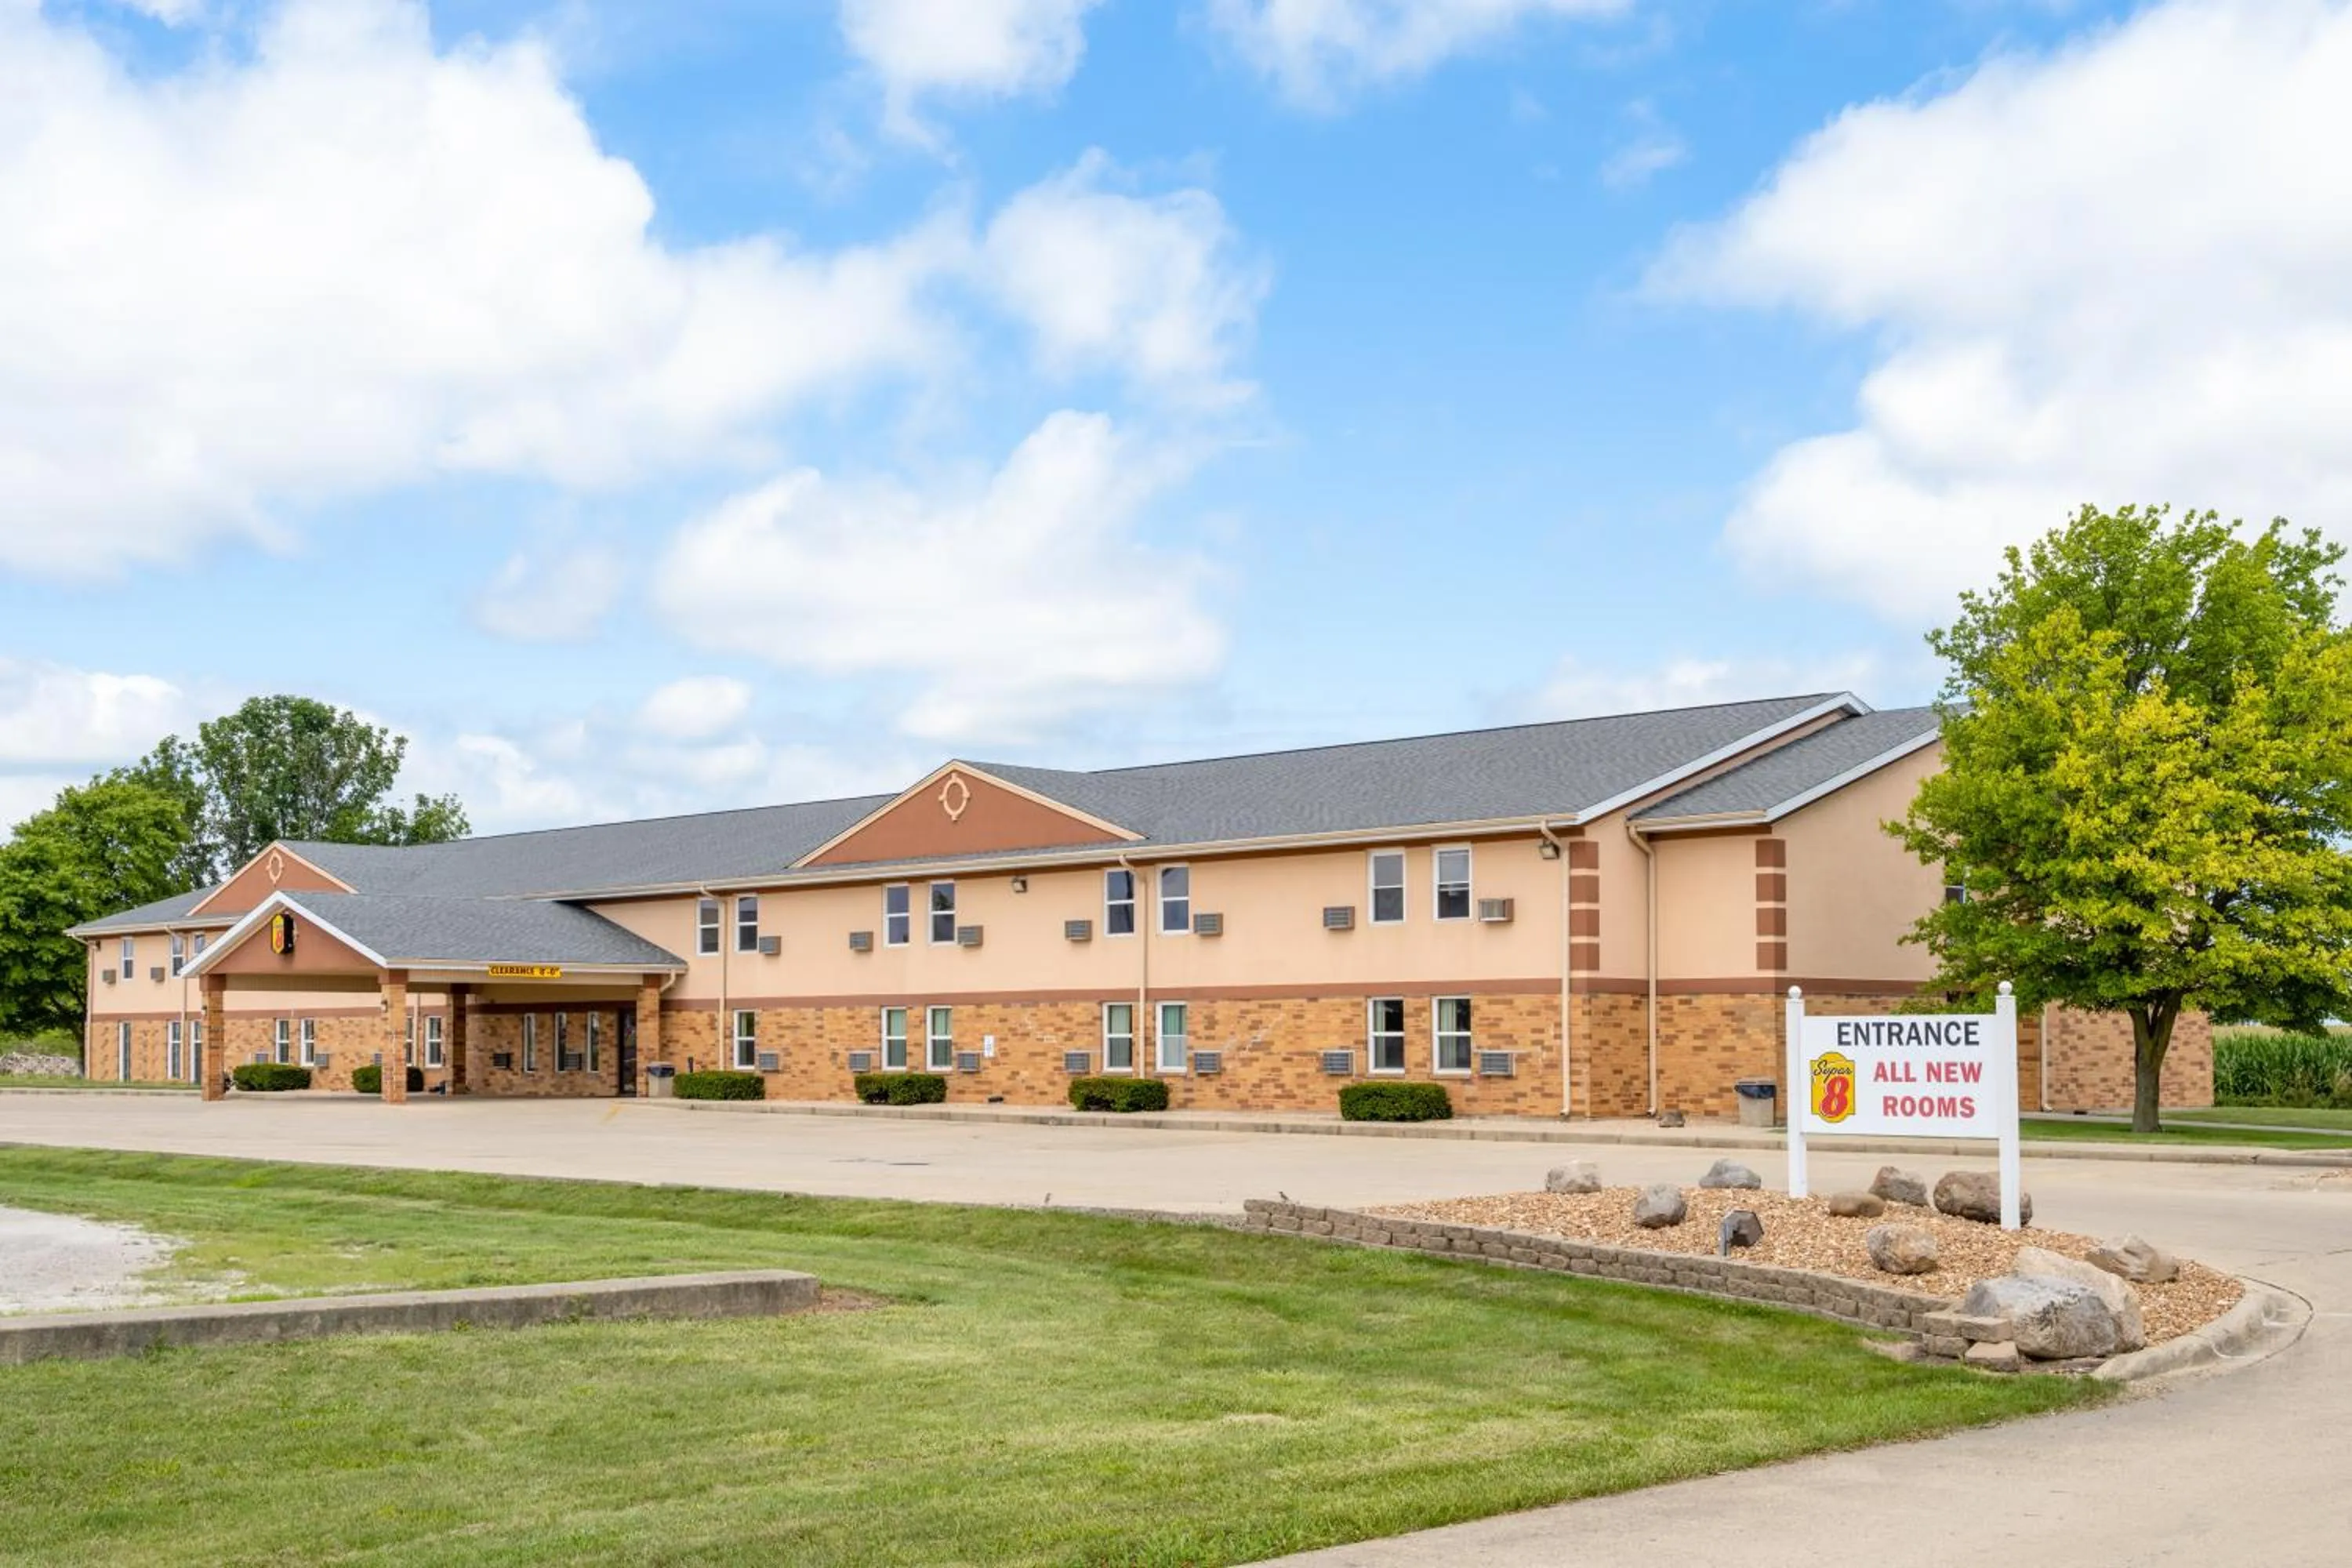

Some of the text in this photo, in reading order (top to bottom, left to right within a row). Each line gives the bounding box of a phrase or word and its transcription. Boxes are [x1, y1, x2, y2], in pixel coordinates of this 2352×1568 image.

[490, 966, 534, 975] CLEARANCE
[1837, 1022, 1980, 1047] ENTRANCE
[1813, 1059, 1853, 1083] Super
[1873, 1062, 1983, 1083] ALL NEW
[1820, 1075, 1850, 1118] 8
[1882, 1095, 1976, 1119] ROOMS
